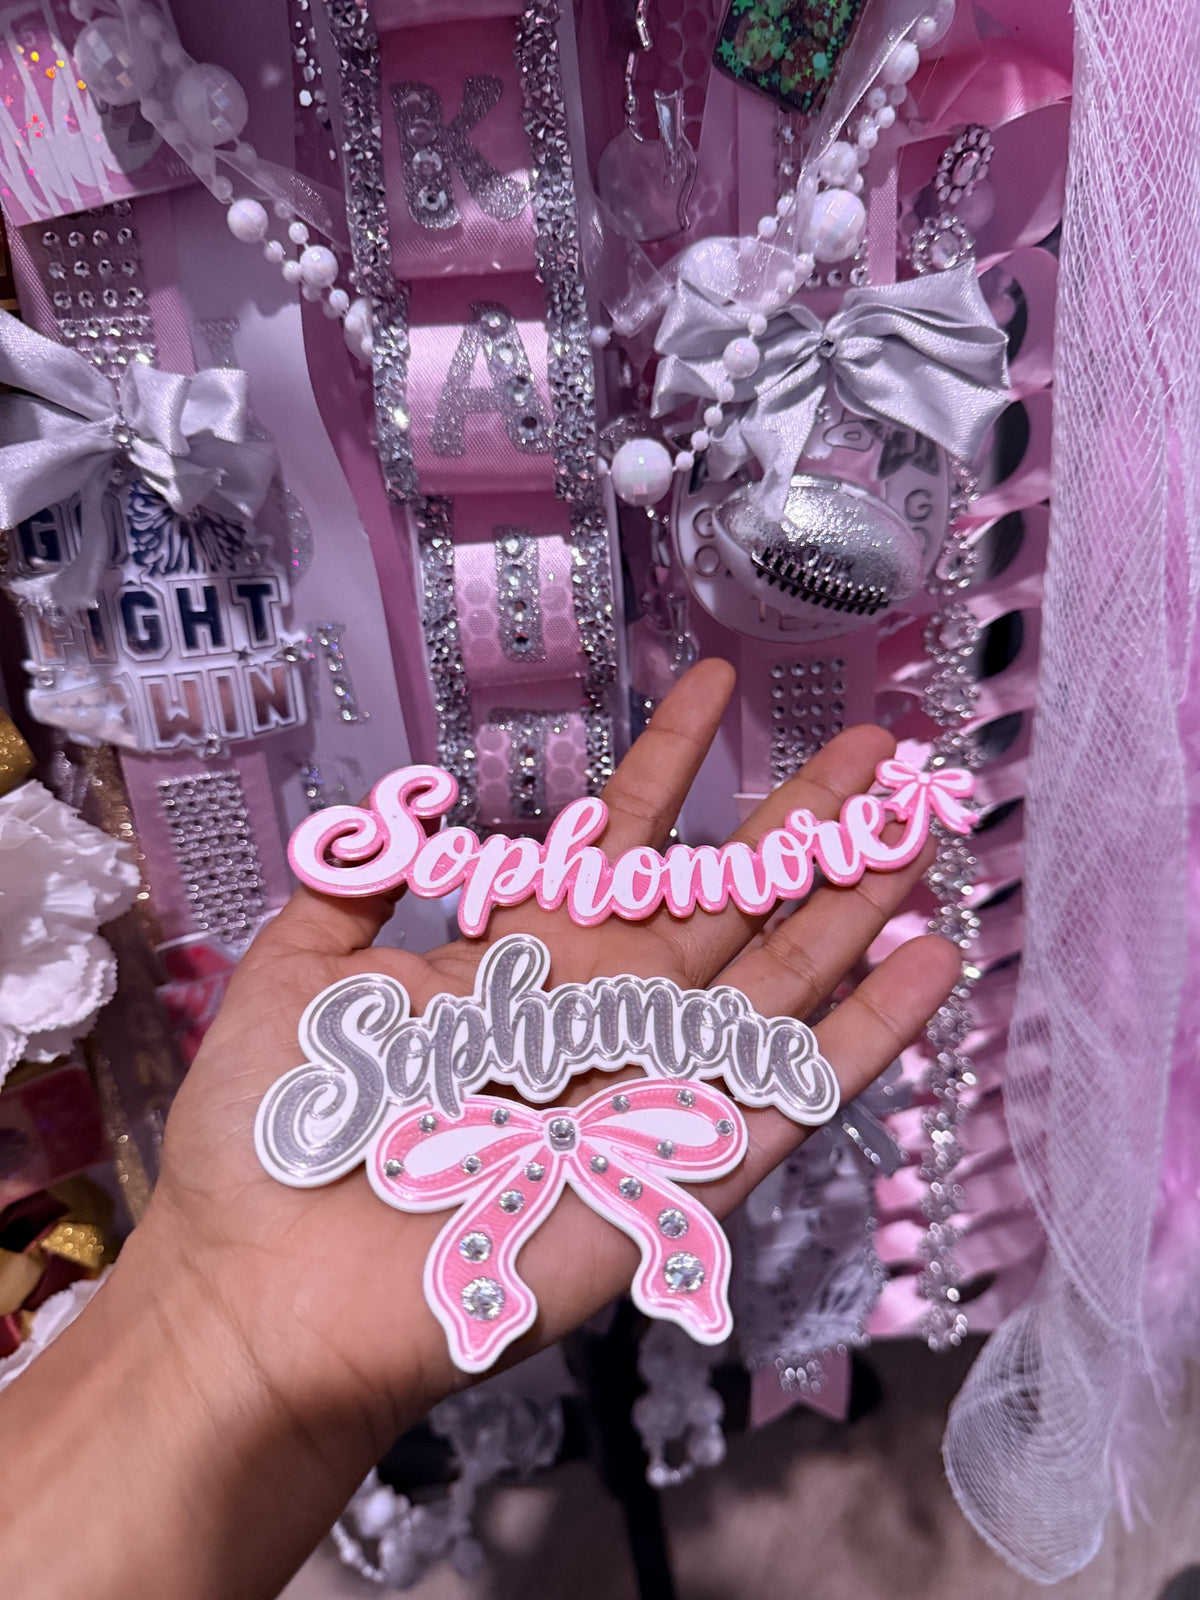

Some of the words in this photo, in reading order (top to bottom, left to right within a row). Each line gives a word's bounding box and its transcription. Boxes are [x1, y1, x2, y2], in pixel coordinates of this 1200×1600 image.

[30, 576, 282, 665] FIGHT
[141, 662, 300, 750] WIN
[289, 763, 932, 938] Sophomore
[256, 935, 838, 1186] Sophomore
